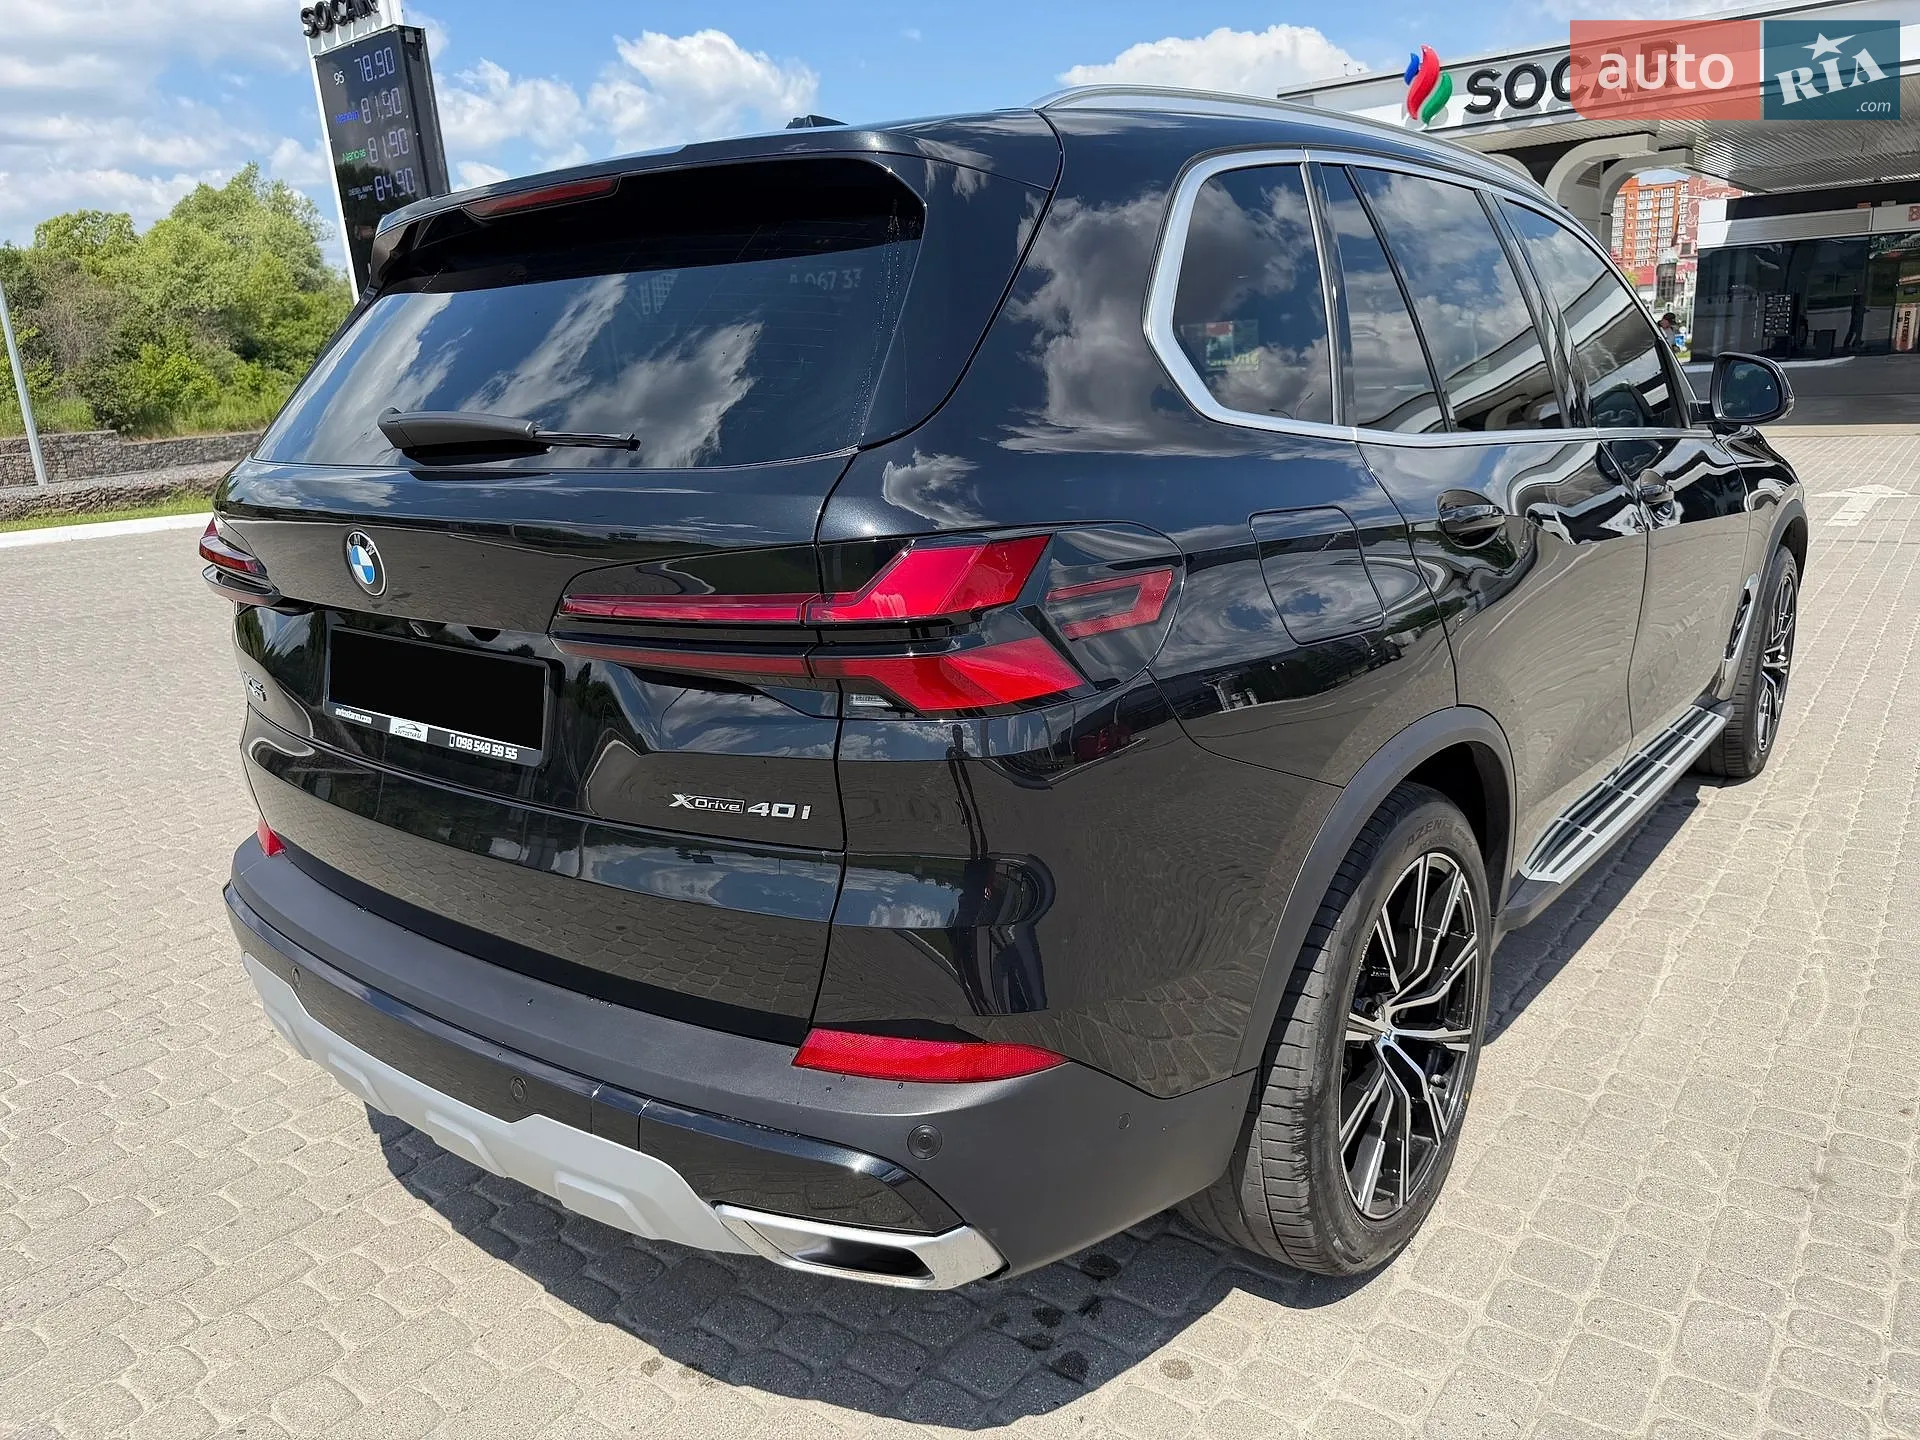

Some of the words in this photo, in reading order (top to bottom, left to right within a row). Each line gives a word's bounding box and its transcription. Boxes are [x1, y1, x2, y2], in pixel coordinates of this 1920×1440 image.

[333, 70, 345, 85] 95
[354, 46, 396, 82] 78.90
[360, 87, 402, 125] 81.90
[367, 127, 410, 164] 81.90
[374, 167, 416, 202] 84.90
[455, 735, 473, 751] 098
[472, 739, 492, 755] 549
[491, 743, 505, 757] 59
[504, 746, 518, 760] 55
